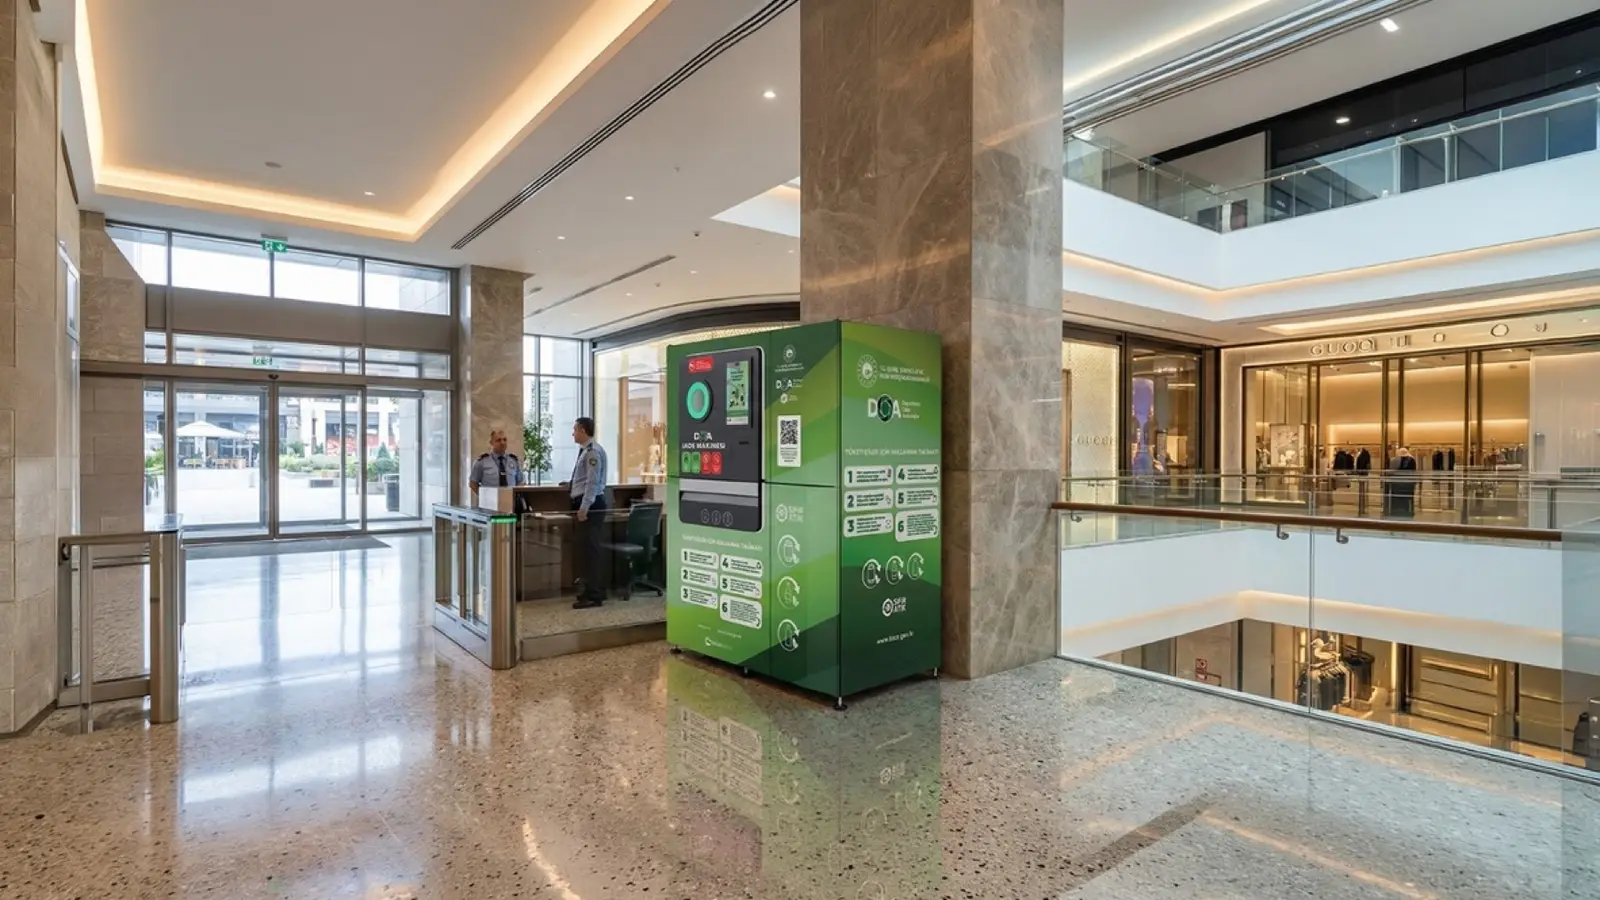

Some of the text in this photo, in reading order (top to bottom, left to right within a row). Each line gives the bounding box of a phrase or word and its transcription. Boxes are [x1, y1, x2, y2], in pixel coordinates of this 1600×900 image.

[847, 470, 853, 483] 1
[898, 468, 905, 481] 4
[847, 494, 854, 508] 2
[897, 492, 904, 505] 5
[847, 519, 855, 533] 3
[897, 520, 905, 533] 6
[683, 551, 688, 561] 1
[721, 557, 729, 569] 4
[682, 569, 689, 580] 2
[721, 578, 728, 589] 5
[682, 588, 689, 599] 3
[721, 601, 728, 613] 6
